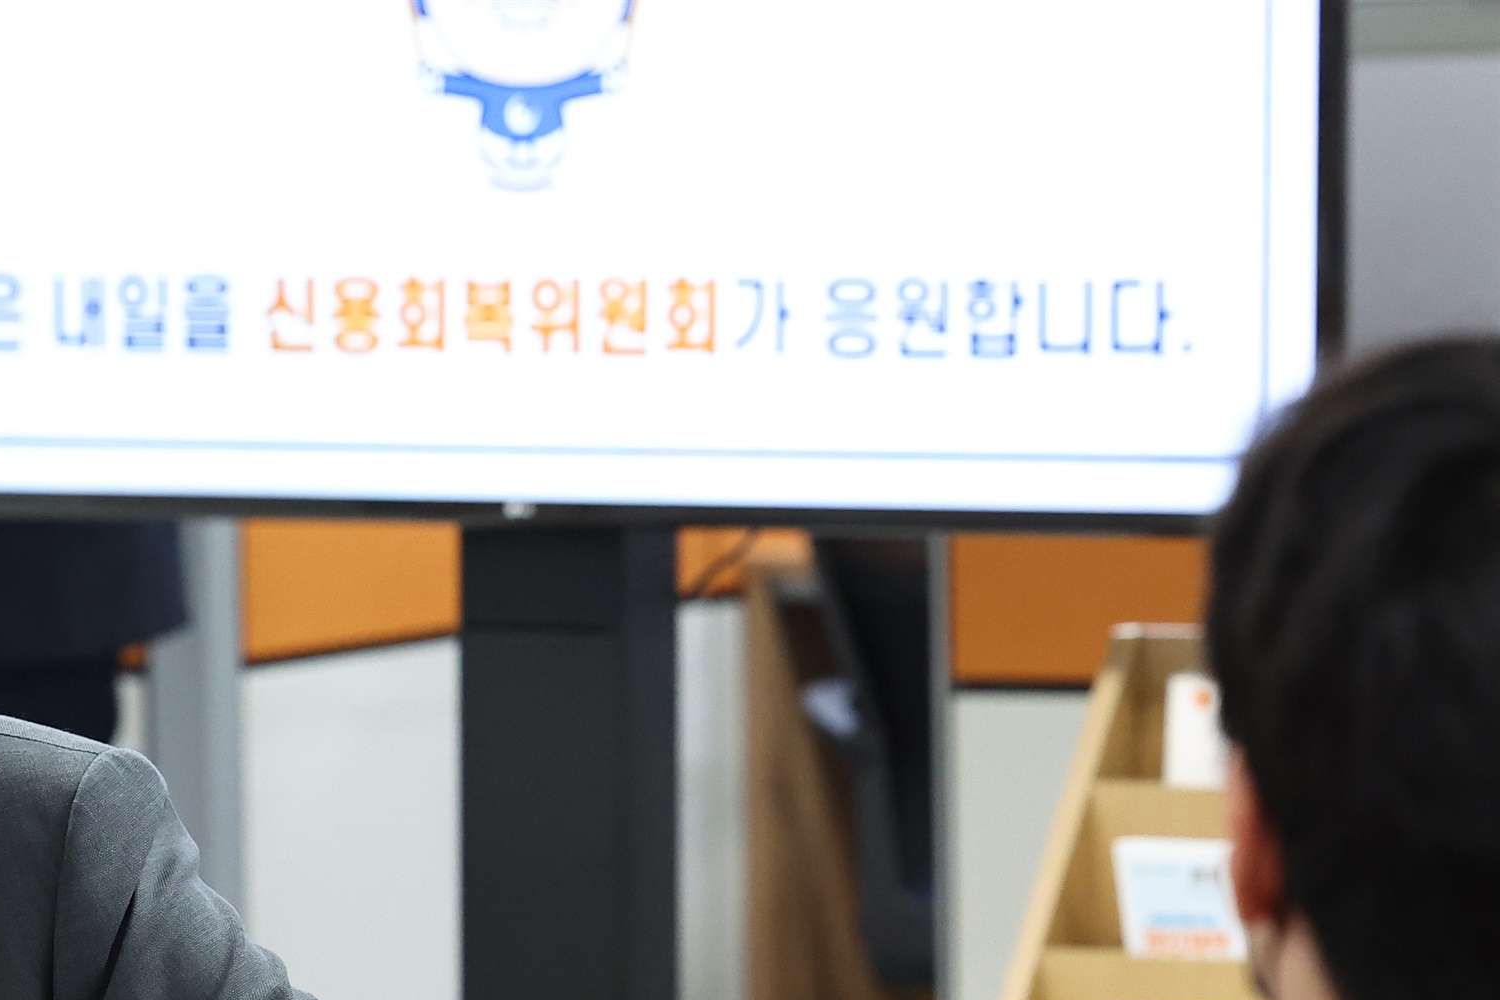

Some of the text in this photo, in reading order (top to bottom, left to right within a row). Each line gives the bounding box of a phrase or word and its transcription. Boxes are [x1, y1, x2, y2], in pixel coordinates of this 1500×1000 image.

[53, 274, 230, 353] 내일을
[268, 276, 792, 355] 신용회복위원회가
[825, 276, 1193, 359] 응원합니다.
